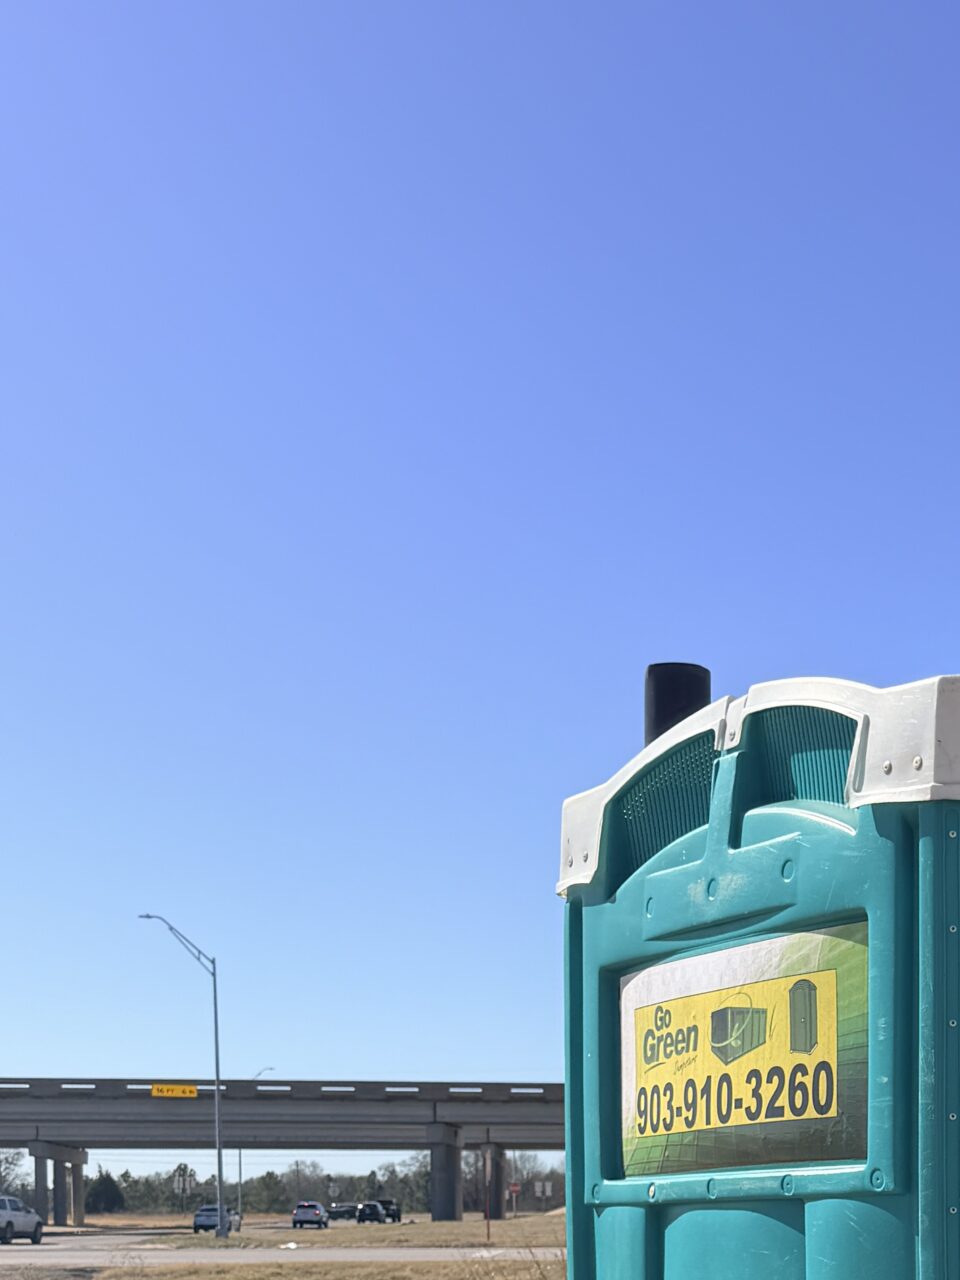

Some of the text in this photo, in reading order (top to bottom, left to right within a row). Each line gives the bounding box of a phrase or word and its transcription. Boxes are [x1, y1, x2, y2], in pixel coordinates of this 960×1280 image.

[654, 1005, 672, 1031] Go
[643, 1024, 699, 1065] Green
[637, 1060, 834, 1135] 903-910-3260
